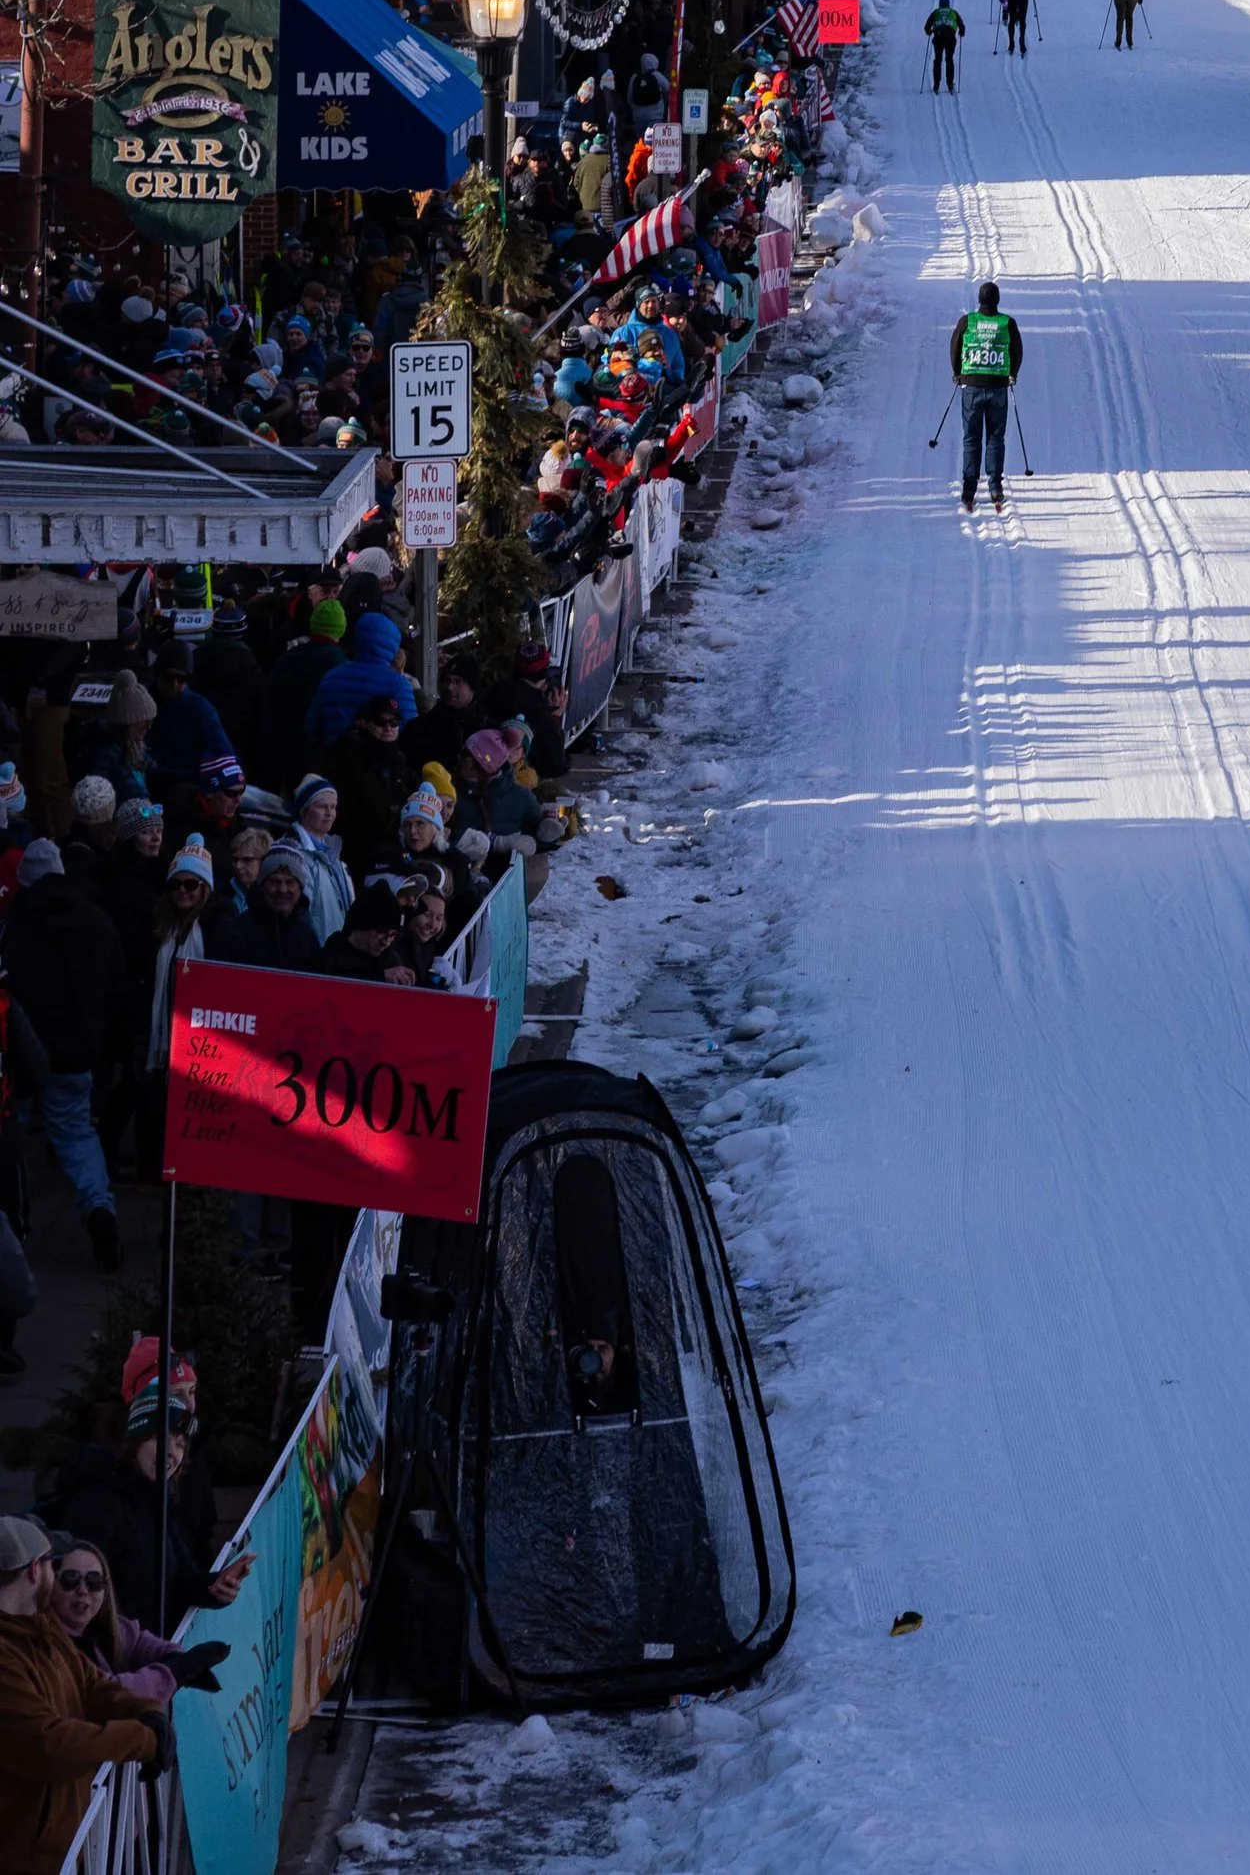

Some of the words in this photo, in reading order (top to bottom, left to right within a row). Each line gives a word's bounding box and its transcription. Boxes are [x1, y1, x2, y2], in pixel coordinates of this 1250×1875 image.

[820, 10, 853, 27] 00M
[100, 4, 274, 90] Anglers
[296, 72, 371, 96] LAKE
[510, 104, 529, 115] ART
[655, 138, 680, 147] PARKING
[662, 127, 672, 137] NO
[113, 136, 230, 167] BAR
[238, 128, 261, 177] &
[300, 136, 369, 161] KIDS
[126, 170, 239, 201] GRILL
[399, 355, 464, 372] SPEED
[406, 380, 456, 397] LIMIT
[410, 405, 455, 447] 15
[421, 468, 438, 483] NO
[407, 487, 452, 503] PARKING
[407, 510, 439, 522] 2:00am
[443, 510, 451, 520] to
[414, 525, 446, 536] 6:00am
[10, 622, 76, 634] INSPIRED
[191, 1007, 257, 1035] BIRKIE
[186, 1036, 222, 1060] Ski.
[186, 1062, 234, 1088] Run.
[184, 1090, 233, 1116] Bike.
[270, 1050, 466, 1143] 300M
[181, 1121, 236, 1144] Live!
